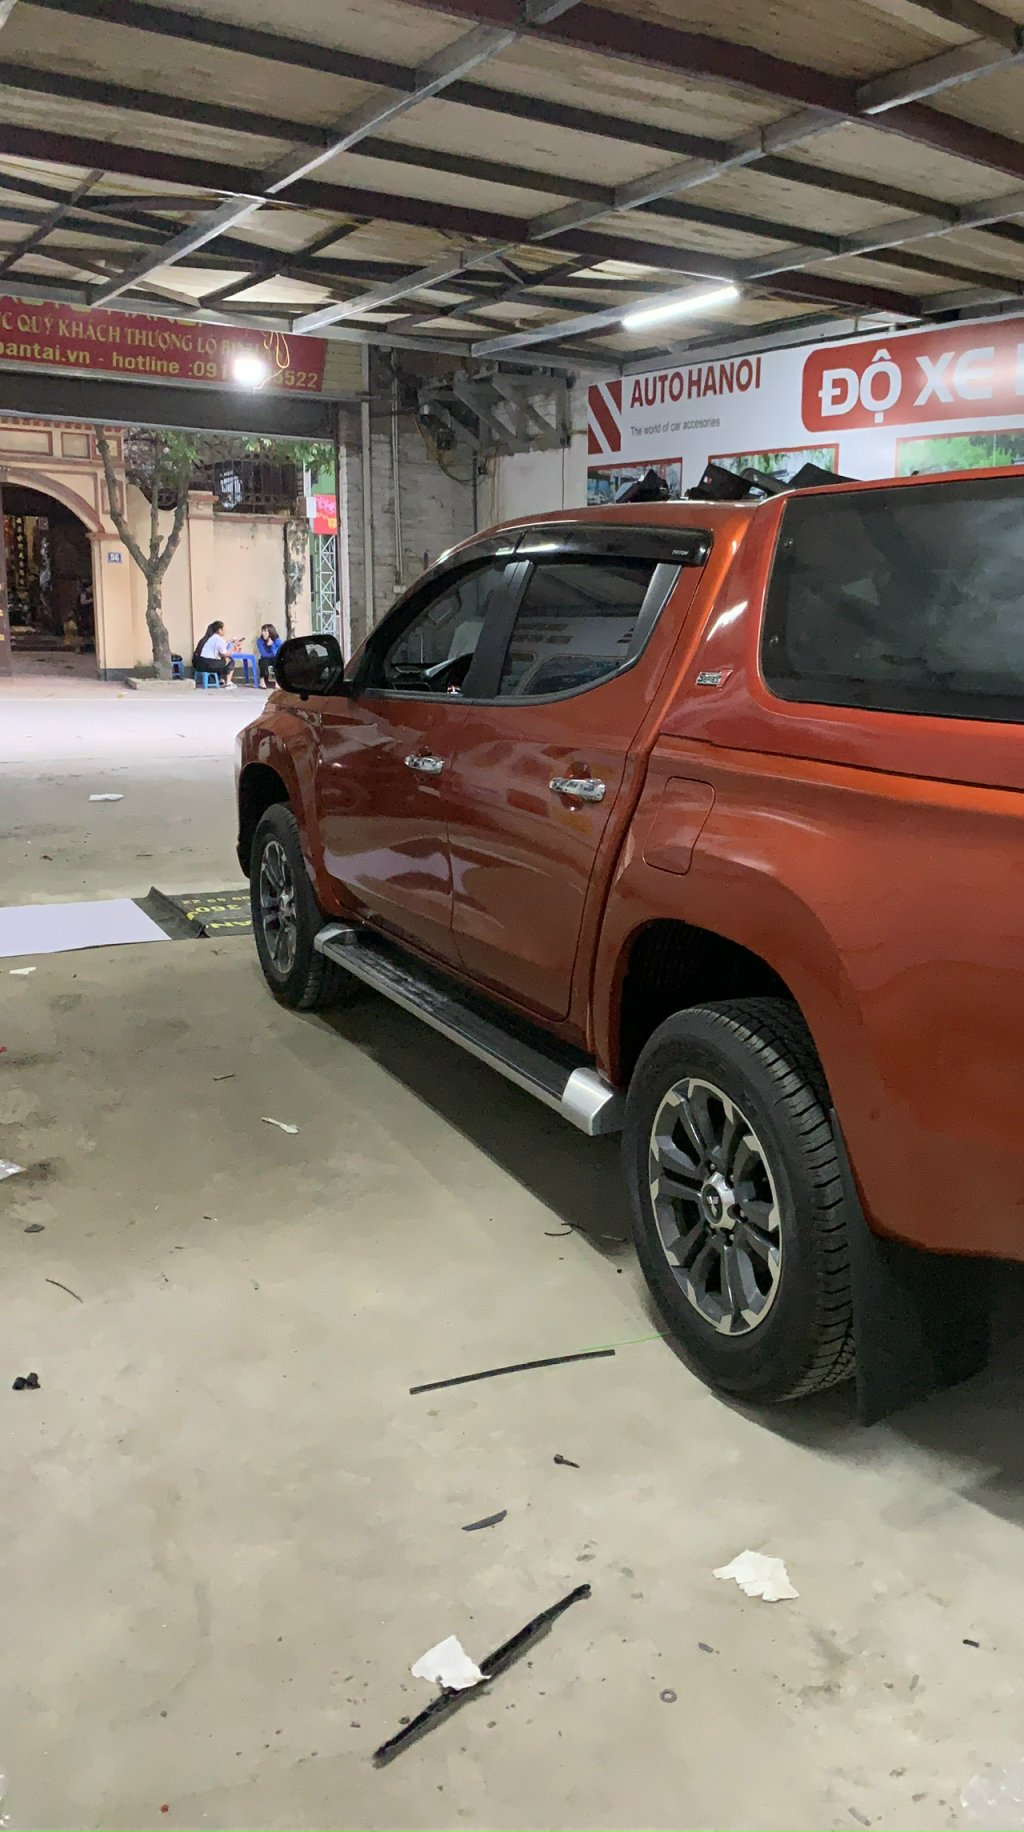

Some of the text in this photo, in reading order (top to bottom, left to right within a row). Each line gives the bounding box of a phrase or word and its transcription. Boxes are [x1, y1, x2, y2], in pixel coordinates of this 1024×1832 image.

[112, 351, 180, 374] hotline
[818, 348, 901, 424] ĐỘ
[913, 345, 994, 406] XE
